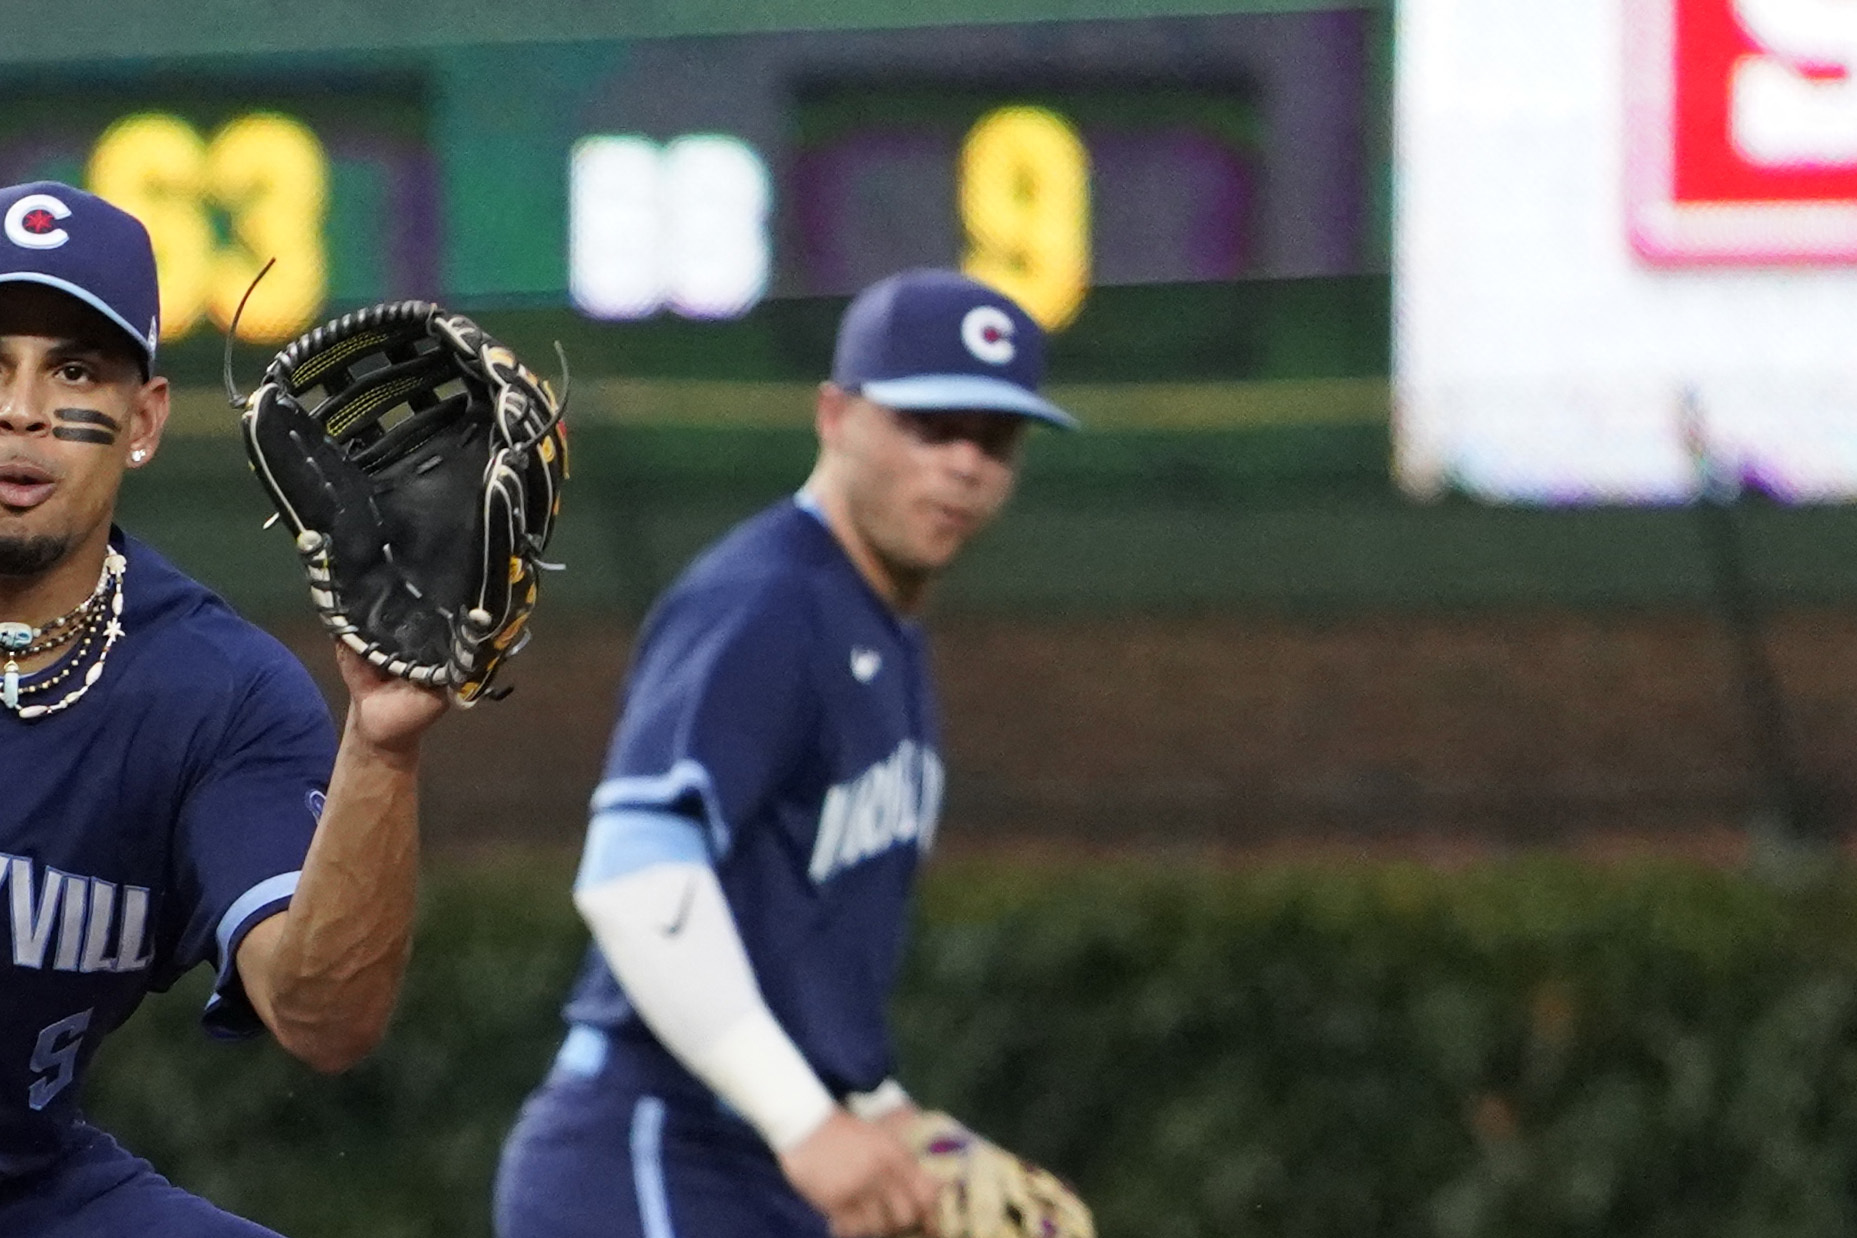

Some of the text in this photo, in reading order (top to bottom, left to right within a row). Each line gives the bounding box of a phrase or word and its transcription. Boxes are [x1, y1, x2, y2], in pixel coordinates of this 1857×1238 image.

[4, 193, 72, 250] C
[87, 110, 328, 346] 63
[959, 104, 1093, 333] 9
[960, 304, 1016, 365] C
